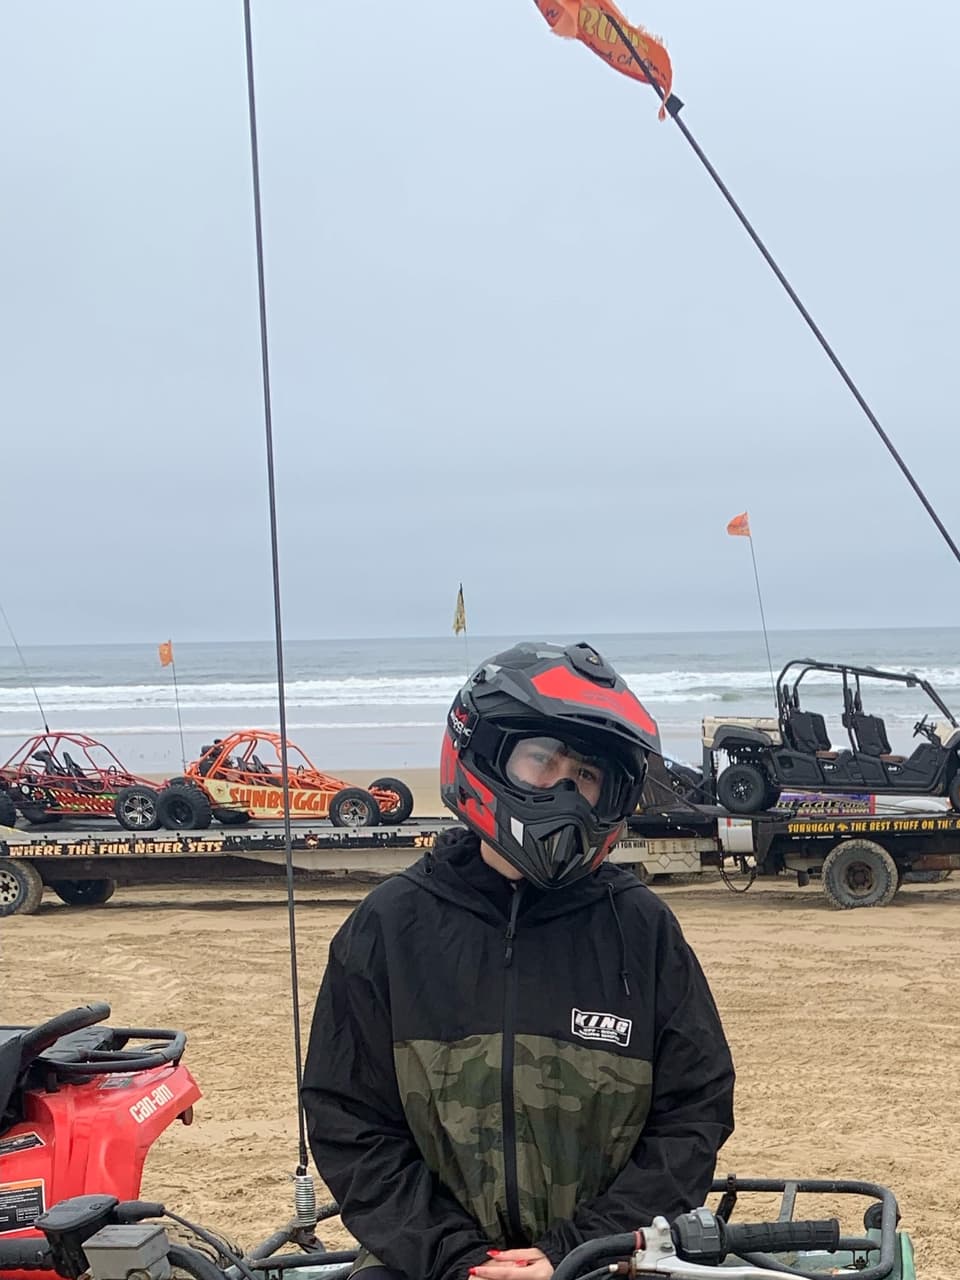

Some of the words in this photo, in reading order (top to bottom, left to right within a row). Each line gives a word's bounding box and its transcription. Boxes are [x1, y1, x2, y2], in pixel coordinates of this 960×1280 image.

[788, 822, 835, 833] SUNBUGGY
[851, 821, 867, 831] THE
[869, 821, 890, 831] BEST
[893, 820, 919, 830] STUFF
[921, 820, 935, 830] ON
[9, 845, 62, 856] WHERE
[67, 844, 95, 855] THE
[134, 841, 183, 854] NEVER
[188, 841, 223, 852] SETS
[575, 1013, 629, 1033] KING
[129, 1084, 174, 1124] can-am
